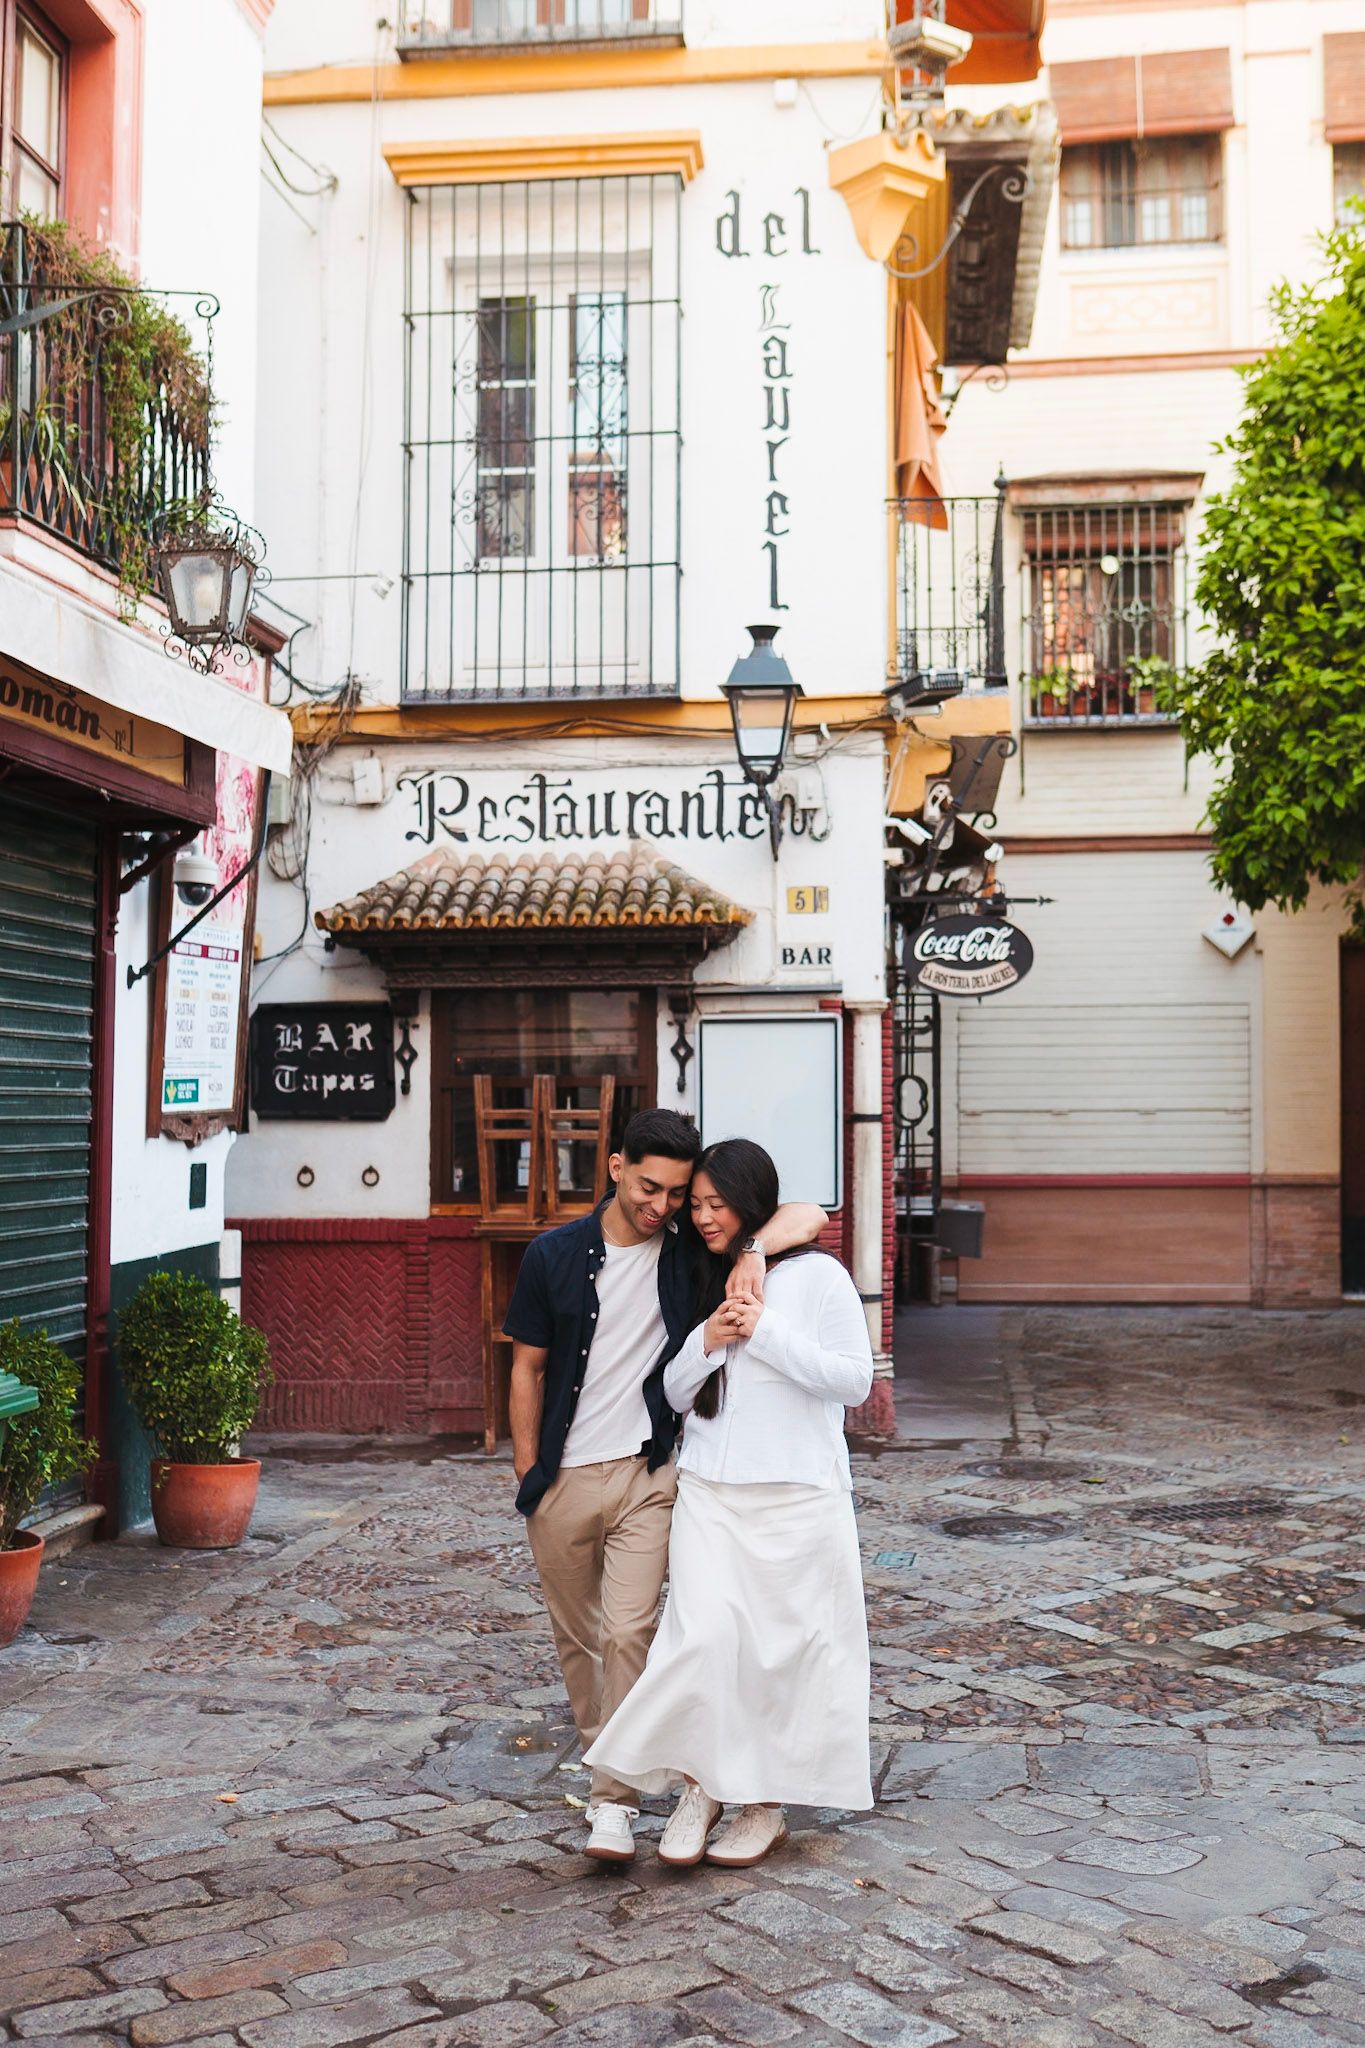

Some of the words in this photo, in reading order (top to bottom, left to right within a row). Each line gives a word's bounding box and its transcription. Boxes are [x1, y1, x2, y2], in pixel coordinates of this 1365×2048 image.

[715, 186, 821, 258] del
[757, 284, 793, 611] Laurel
[397, 770, 765, 844] Restaurante
[782, 947, 832, 965] BAR
[274, 1022, 373, 1060] BAR
[273, 1065, 375, 1099] Tapas
